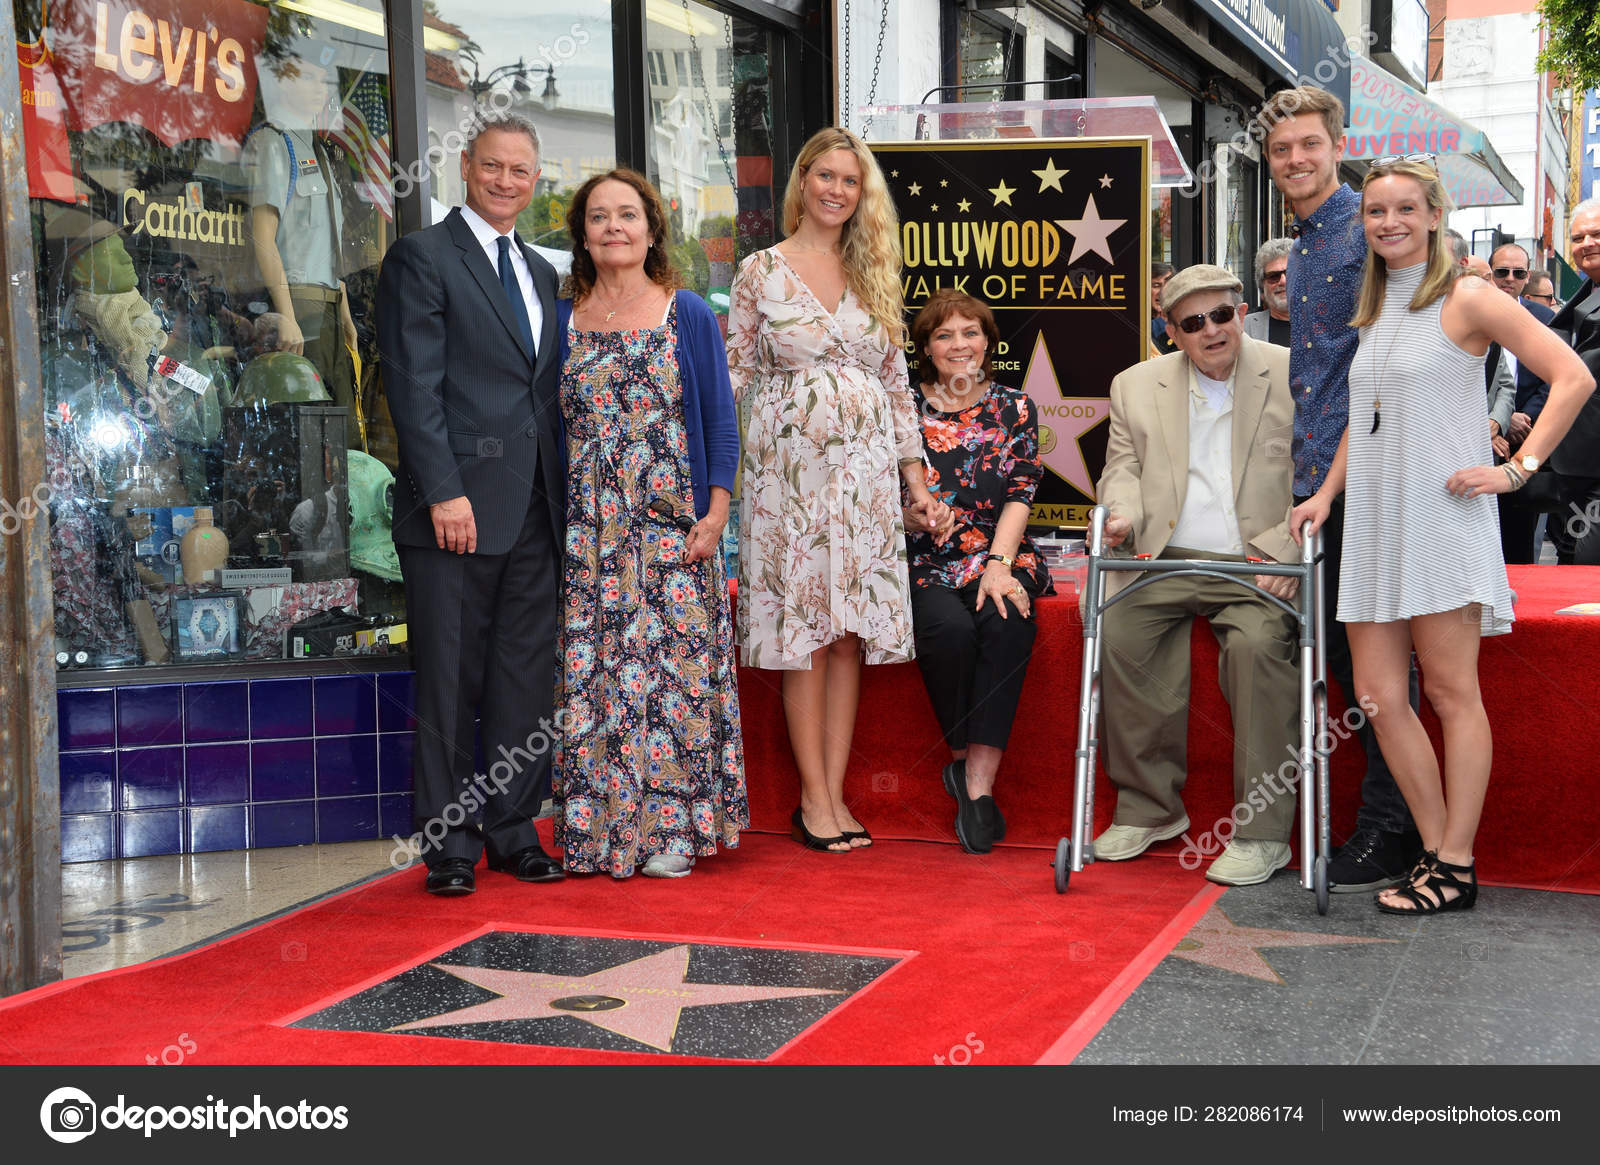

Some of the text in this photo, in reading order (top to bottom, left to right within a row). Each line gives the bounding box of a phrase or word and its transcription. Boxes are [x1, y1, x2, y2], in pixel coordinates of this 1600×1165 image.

[1348, 130, 1460, 157] UVENIR
[123, 187, 245, 246] Carhartt
[897, 219, 1060, 270] OLLYWOOD
[982, 274, 1027, 299] OF
[1039, 274, 1126, 300] FAME
